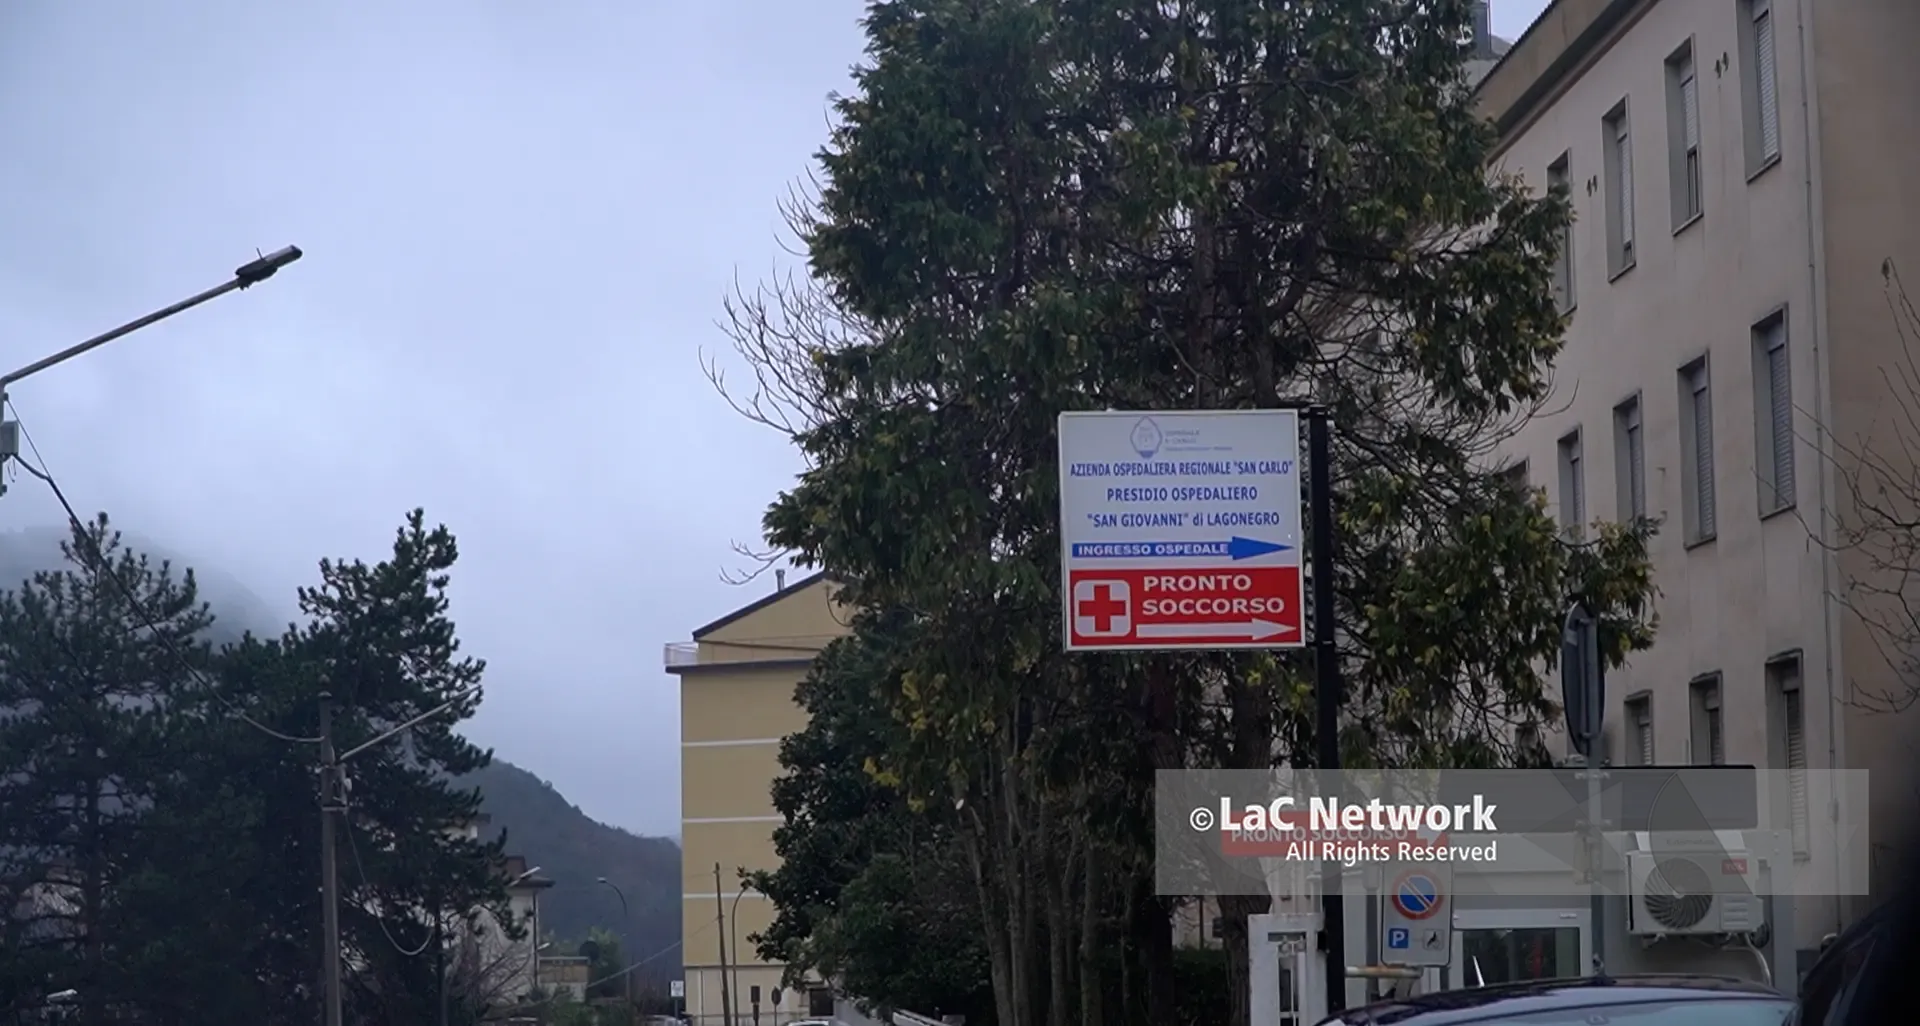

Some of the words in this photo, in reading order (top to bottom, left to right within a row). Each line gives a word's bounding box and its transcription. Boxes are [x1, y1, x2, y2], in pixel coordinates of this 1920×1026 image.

[1070, 463, 1111, 477] AZIENDA
[1113, 462, 1177, 476] OSPEDALIERA
[1179, 461, 1231, 475] REGIONALE
[1233, 461, 1257, 474] "SAN
[1259, 461, 1294, 474] CARLO"
[1107, 487, 1168, 502] PRESIDIO
[1171, 486, 1258, 501] OSPEDALIERO
[1087, 513, 1117, 527] "SAN
[1120, 512, 1189, 527] GIOVANNI"
[1192, 512, 1204, 526] di
[1207, 511, 1280, 526] LAGONEGRO
[1078, 544, 1152, 556] INGRESSO
[1154, 543, 1229, 555] OSPEDALE
[1143, 574, 1252, 592] PRONTO
[1142, 597, 1285, 616] SOCCORSO
[1231, 825, 1306, 842] PRONTO
[1311, 825, 1408, 842] SOCCORSO
[1391, 930, 1405, 947] P
